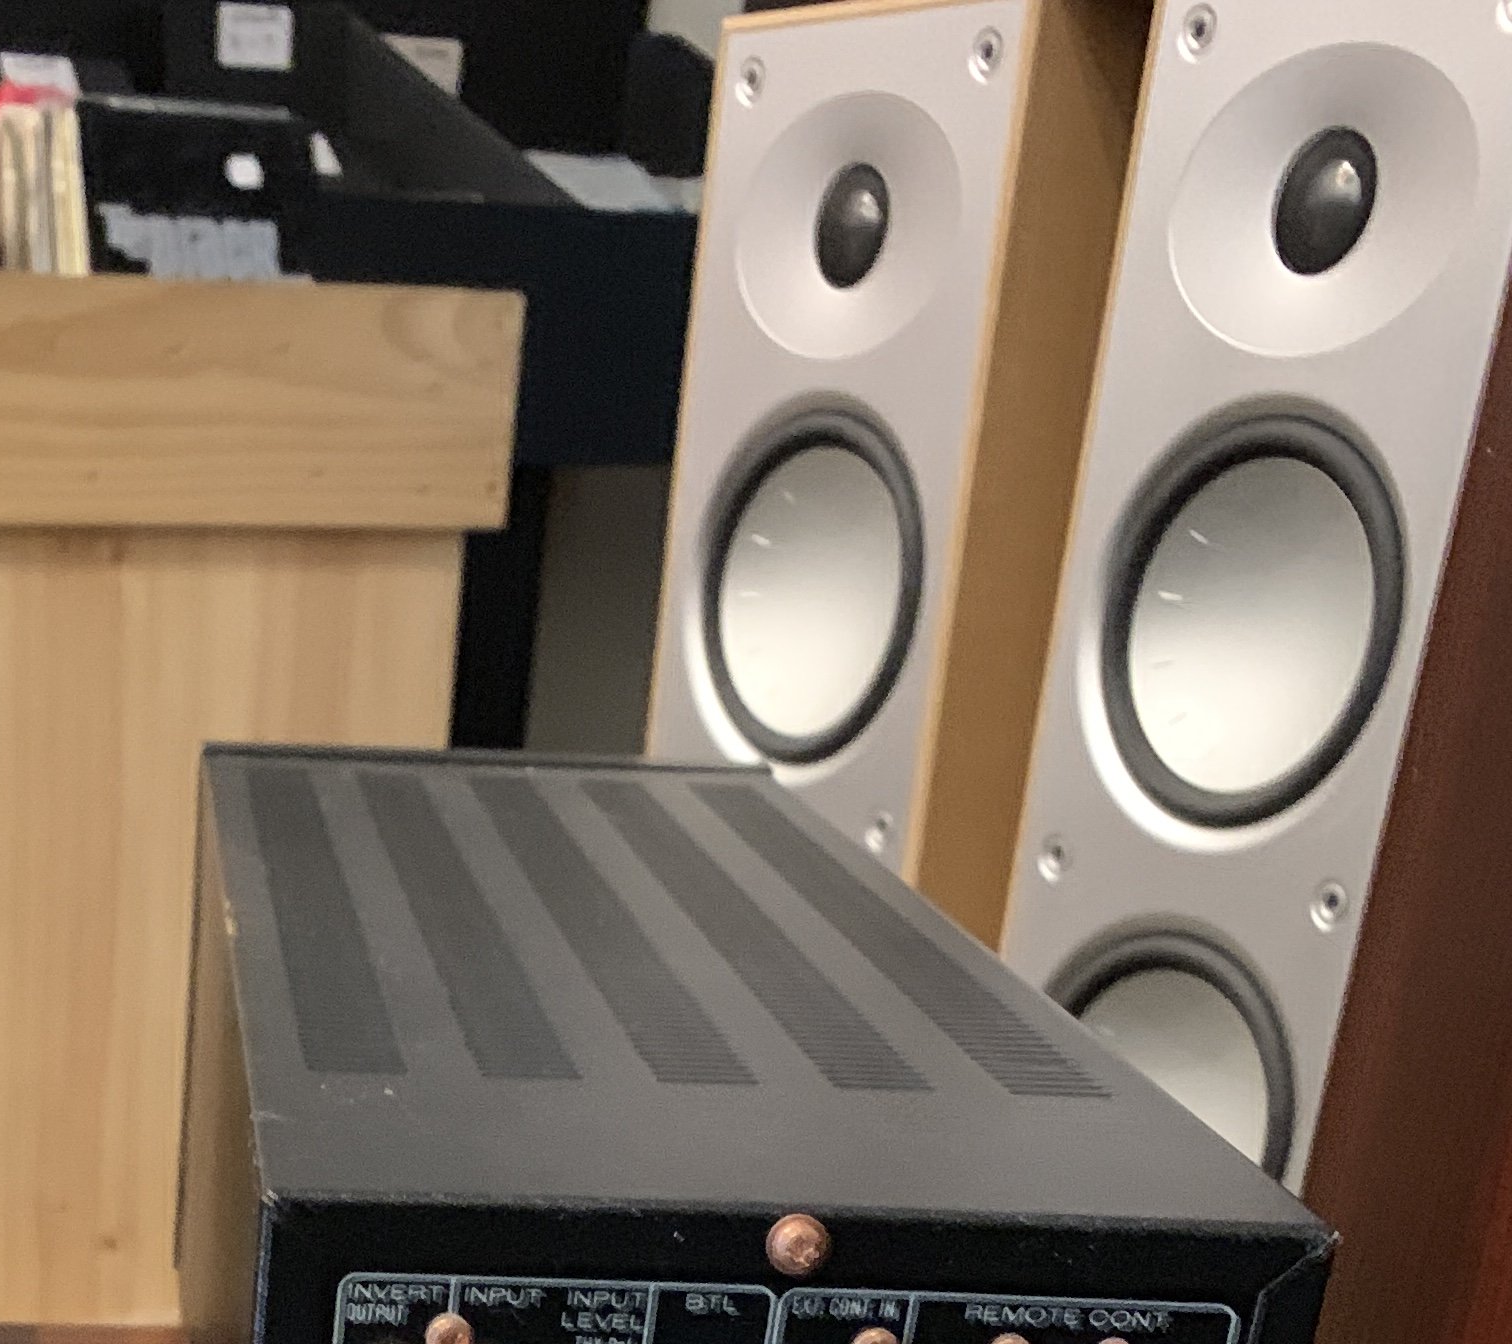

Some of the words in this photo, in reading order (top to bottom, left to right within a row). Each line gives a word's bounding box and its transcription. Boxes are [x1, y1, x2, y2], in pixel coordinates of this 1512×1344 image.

[348, 1283, 449, 1304] INVERT
[465, 1287, 546, 1308] INPUT
[567, 1290, 648, 1311] INPUT
[685, 1293, 740, 1315] BTL
[560, 1311, 646, 1333] LEVEL
[964, 1303, 1085, 1332] REMOTE
